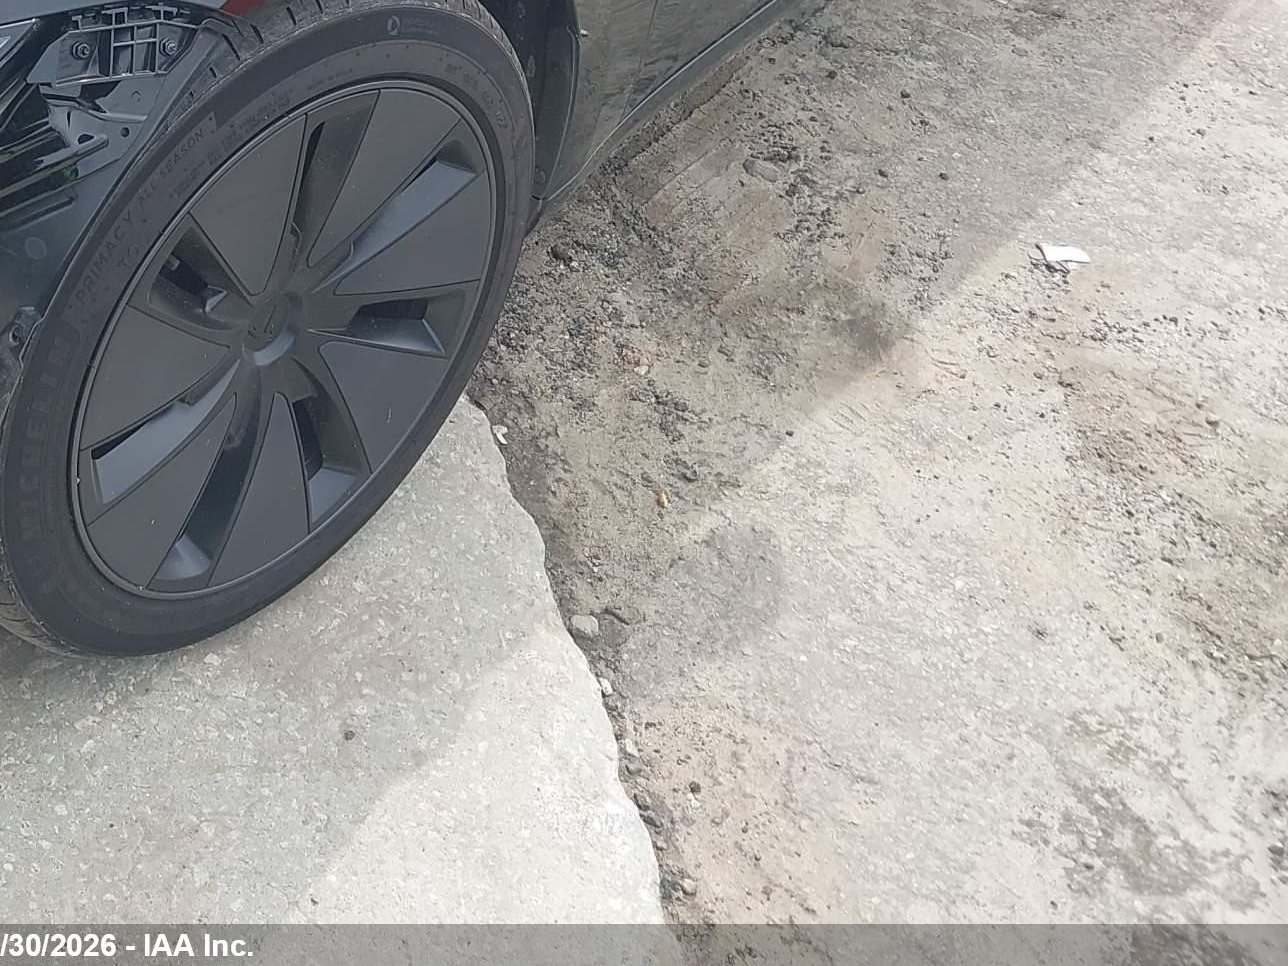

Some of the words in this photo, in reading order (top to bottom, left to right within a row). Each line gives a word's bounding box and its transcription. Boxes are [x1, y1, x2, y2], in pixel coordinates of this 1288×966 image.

[76, 209, 134, 300] PRIMACY
[137, 175, 160, 208] ALL
[160, 129, 205, 179] SEASON
